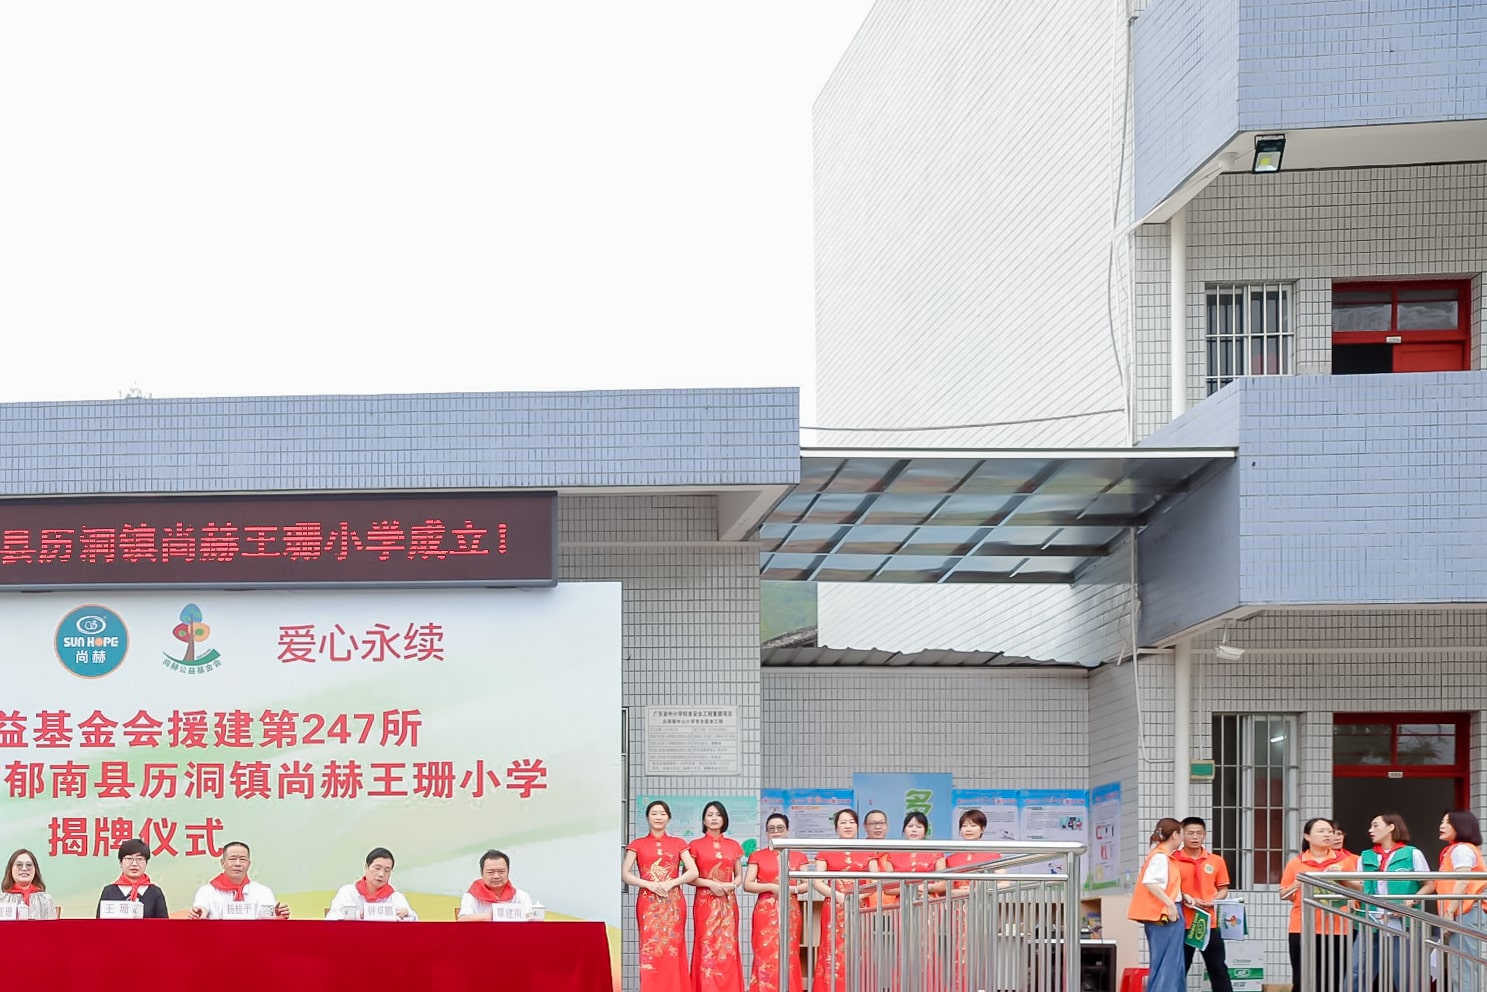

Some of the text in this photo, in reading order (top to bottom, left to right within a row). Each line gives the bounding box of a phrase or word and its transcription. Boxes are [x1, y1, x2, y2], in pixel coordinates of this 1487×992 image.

[63, 636, 120, 648] SUN HOPE
[278, 622, 444, 663] 爱心永续
[75, 649, 107, 664] 尚赫
[49, 817, 225, 857] 揭牌仪式
